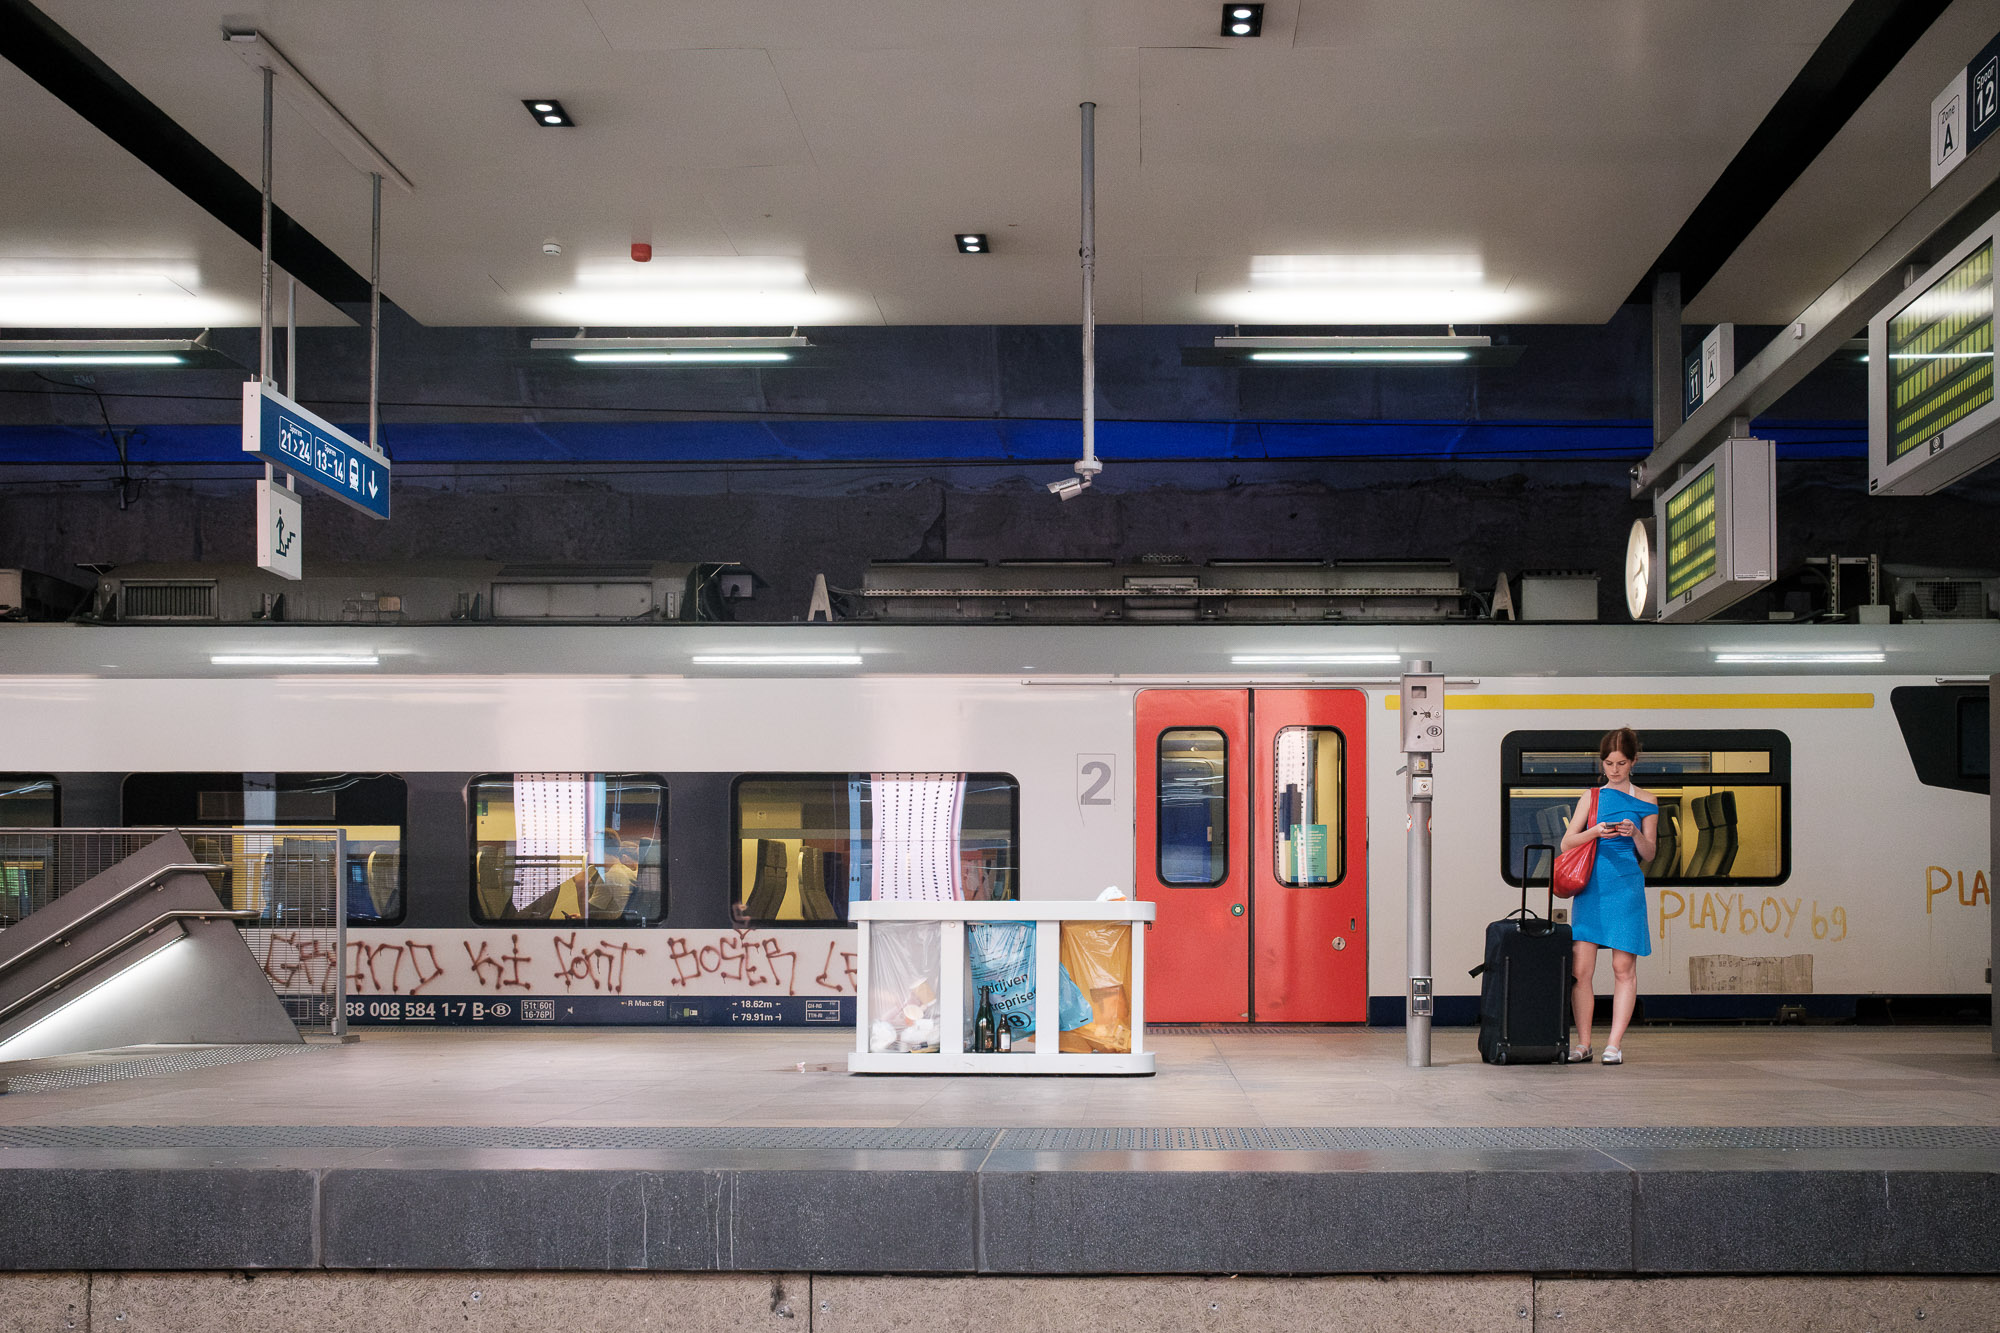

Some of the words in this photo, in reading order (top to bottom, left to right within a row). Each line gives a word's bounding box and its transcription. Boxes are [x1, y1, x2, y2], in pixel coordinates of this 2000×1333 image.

[1976, 65, 1994, 90] Spoor
[1977, 80, 1994, 121] 12
[1942, 104, 1955, 124] Zone
[1943, 123, 1953, 157] A
[1709, 360, 1714, 383] A
[1691, 374, 1698, 398] 11
[289, 424, 302, 438] Sporen
[324, 444, 337, 457] Sporen
[1081, 761, 1111, 805] 2
[370, 1002, 400, 1018] 008
[405, 1002, 436, 1018] 584
[442, 1002, 466, 1017] 1-7
[524, 1001, 537, 1010] 51t
[539, 1001, 552, 1010] 60t
[741, 1000, 772, 1008] 18.62m
[741, 1013, 773, 1021] 79.91m
